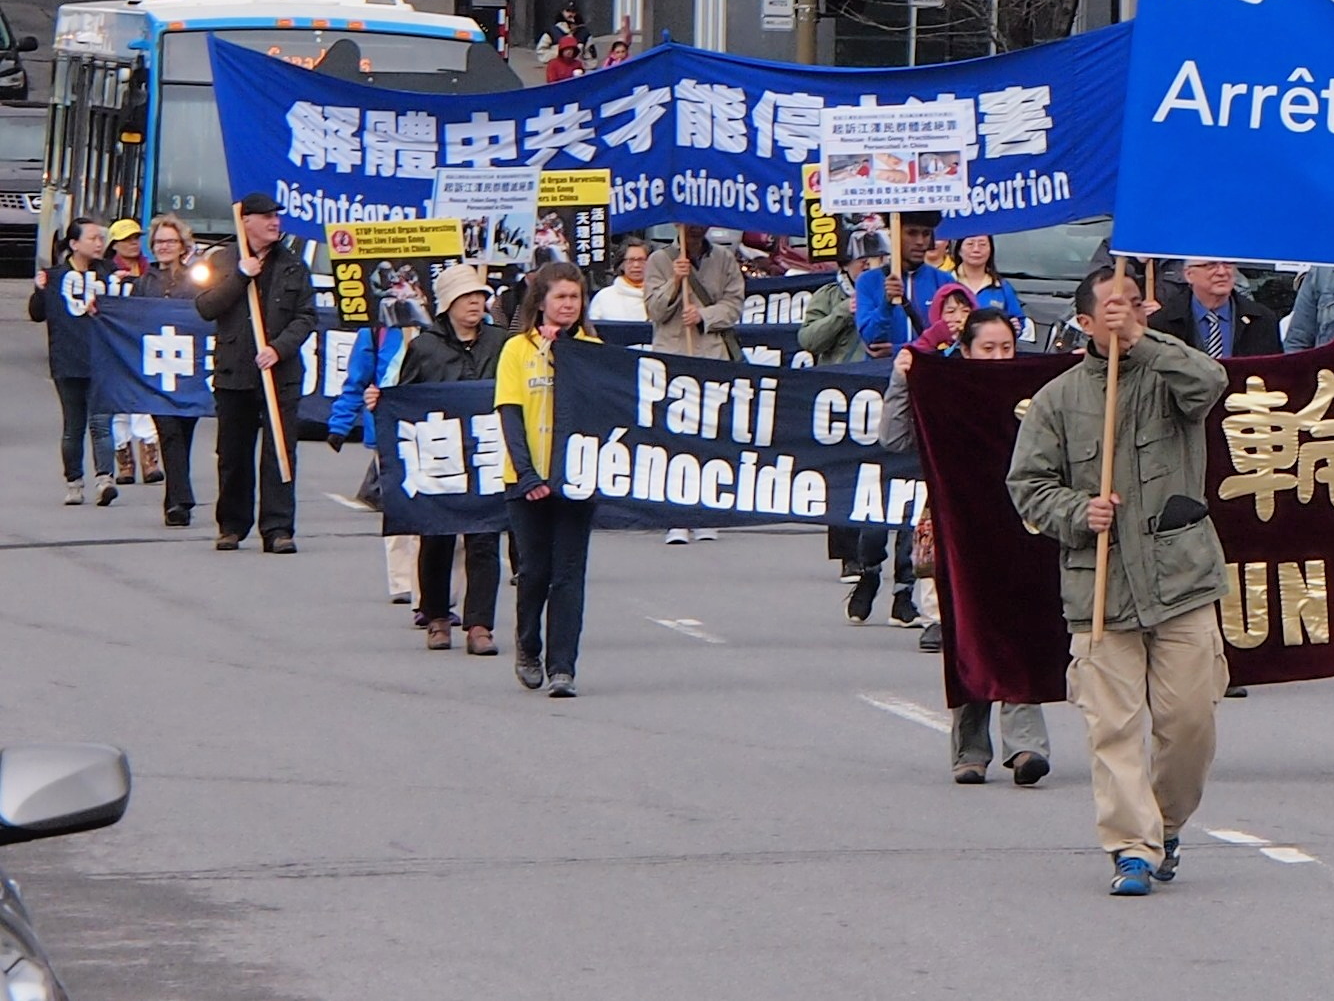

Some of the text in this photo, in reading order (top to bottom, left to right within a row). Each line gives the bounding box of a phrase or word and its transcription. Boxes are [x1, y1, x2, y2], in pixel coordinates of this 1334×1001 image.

[285, 77, 1053, 180] 解體中共才能停害
[547, 176, 567, 184] Organ
[569, 175, 606, 183] Harvesting
[557, 185, 574, 193] Gong
[671, 169, 760, 213] chinois
[766, 181, 794, 217] et
[358, 246, 401, 254] Practitioners
[388, 236, 407, 244] Falun
[408, 235, 425, 243] Gong
[398, 226, 418, 234] Organ
[419, 225, 457, 233] Harvesting
[336, 263, 369, 321] SOS!
[636, 356, 883, 447] Parti co
[562, 426, 827, 517] génocide
[1219, 559, 1330, 649] UN
